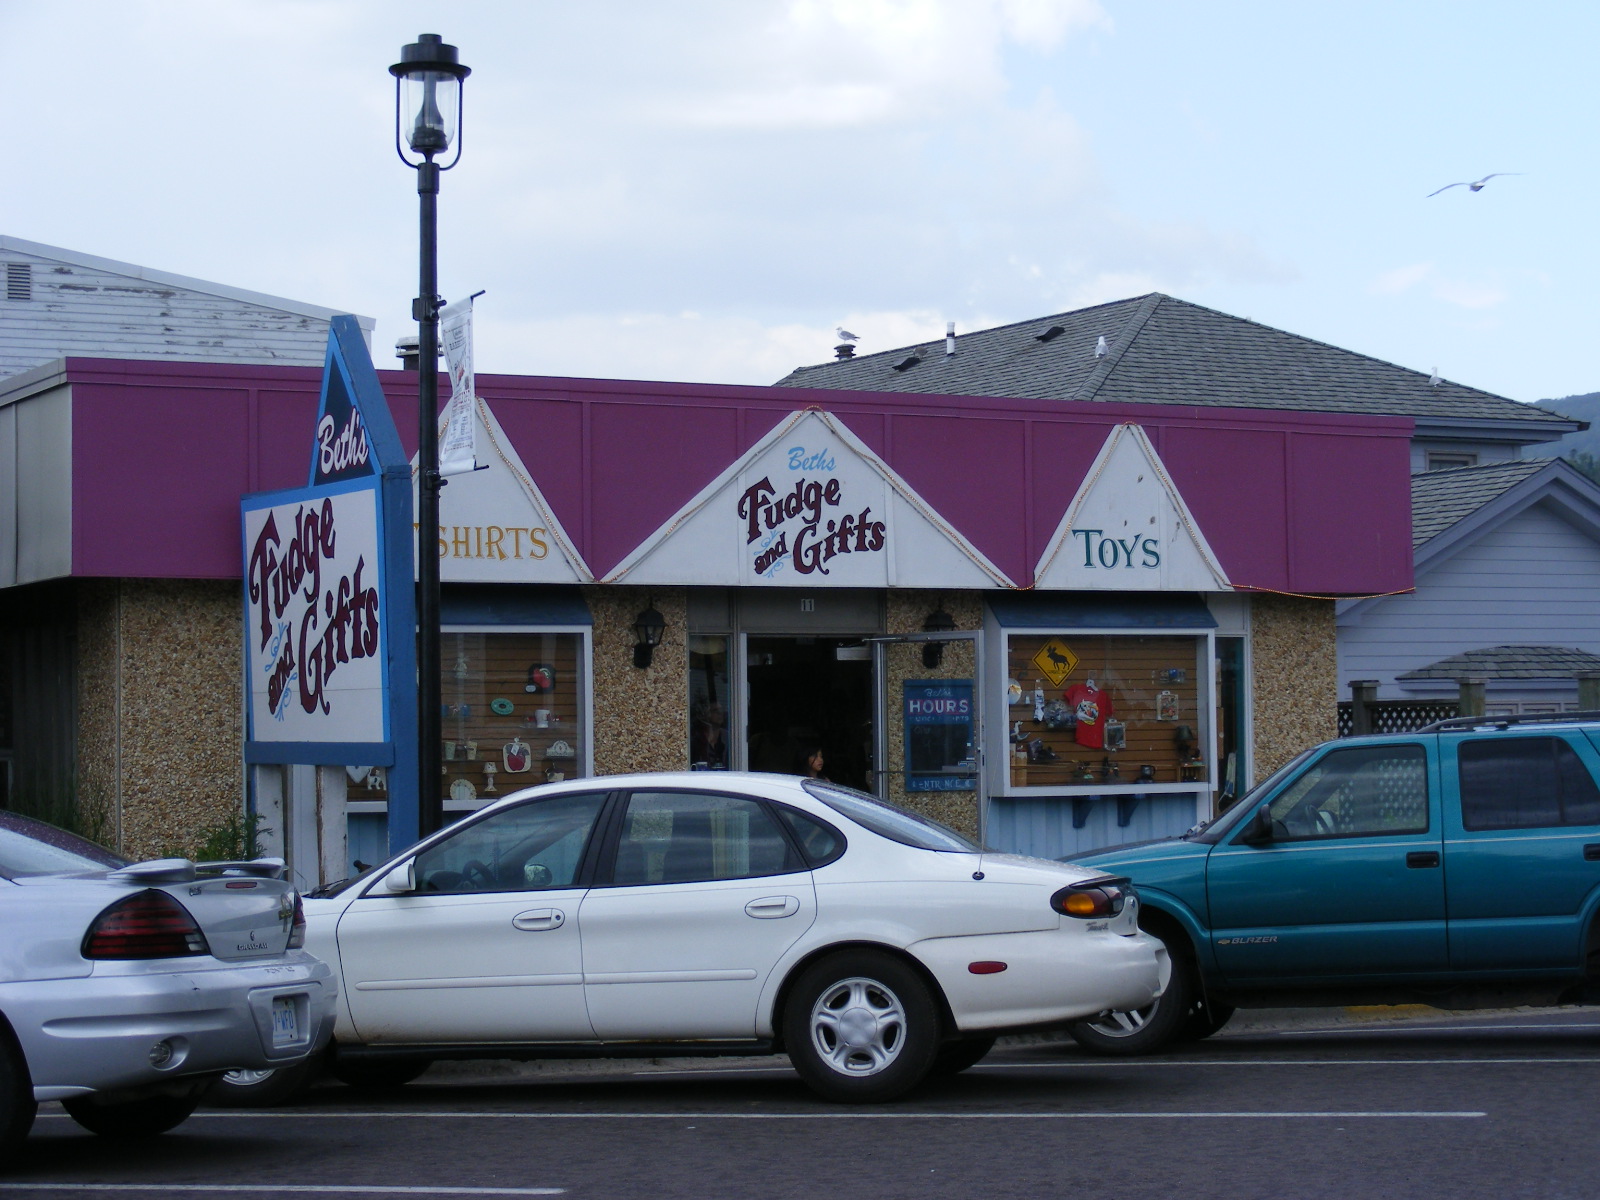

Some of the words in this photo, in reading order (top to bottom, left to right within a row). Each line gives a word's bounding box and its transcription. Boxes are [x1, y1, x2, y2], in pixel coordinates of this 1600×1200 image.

[317, 405, 369, 474] Beth's
[787, 446, 837, 472] Beths
[737, 476, 842, 545] Fudge
[792, 506, 886, 576] Gifts
[248, 497, 336, 652] Fudge
[754, 531, 789, 575] and
[268, 621, 295, 715] and
[298, 554, 379, 716] Gifts
[909, 699, 969, 714] HOURS
[1231, 936, 1278, 944] BLAZER
